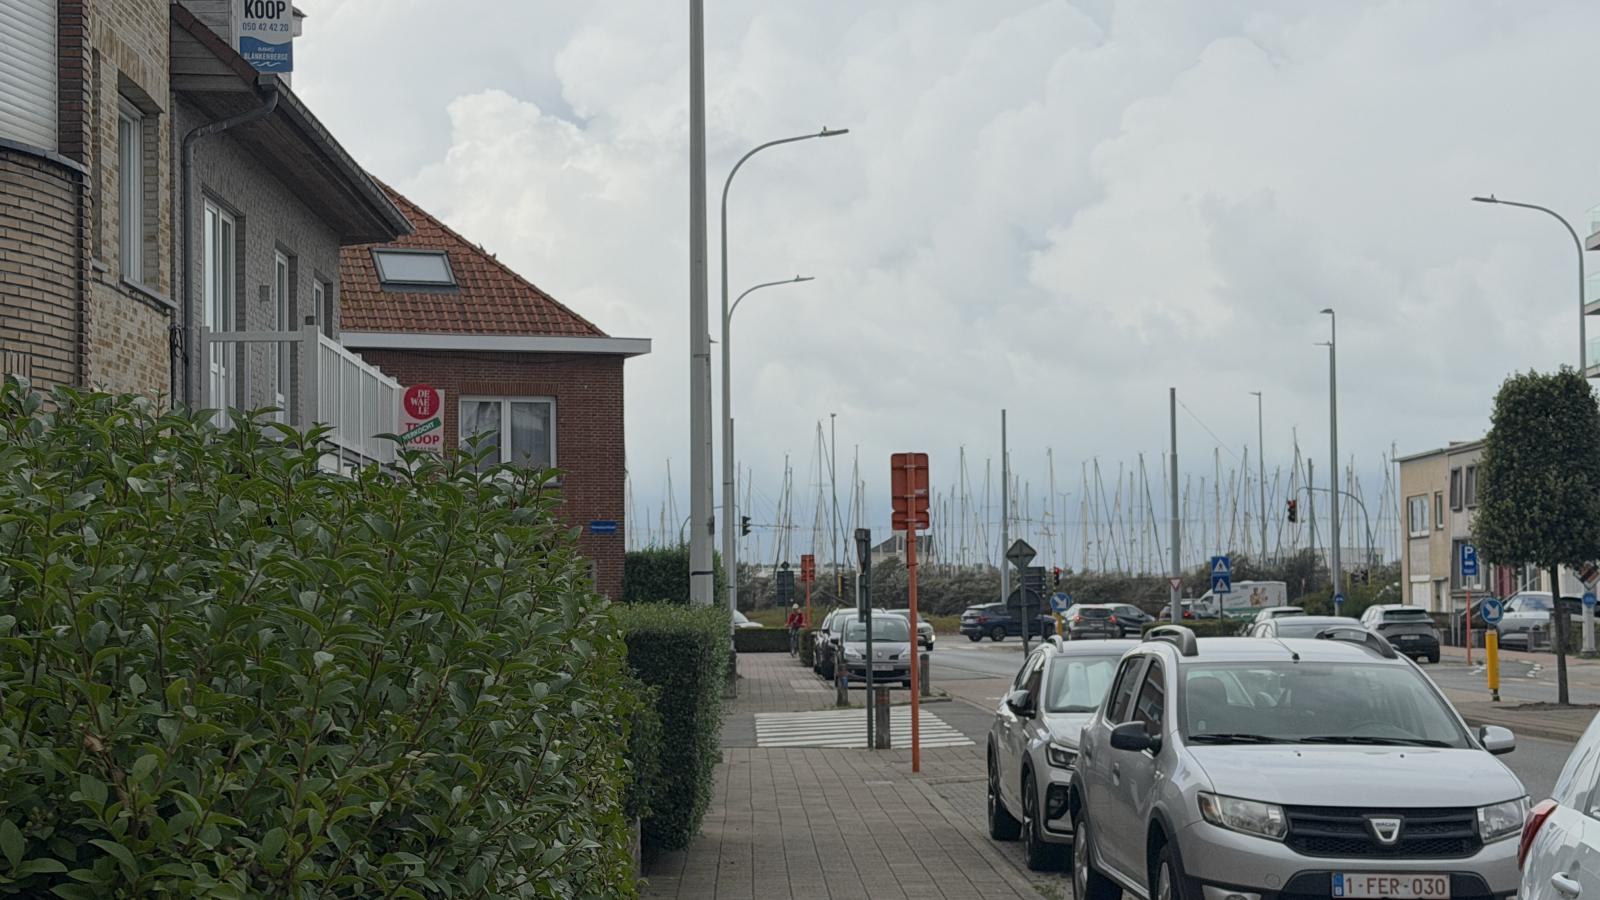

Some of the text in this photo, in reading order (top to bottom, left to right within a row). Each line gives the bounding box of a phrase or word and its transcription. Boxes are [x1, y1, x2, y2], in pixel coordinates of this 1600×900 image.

[244, 0, 286, 19] KOOP
[242, 22, 289, 32] 050 42 42 20
[243, 52, 288, 60] BLANKENBERGE
[417, 389, 430, 398] DE
[410, 397, 430, 407] WAE
[418, 406, 430, 416] LE
[410, 434, 440, 445] OOP
[1464, 546, 1474, 560] P
[1345, 877, 1446, 895] 1-FER-030
